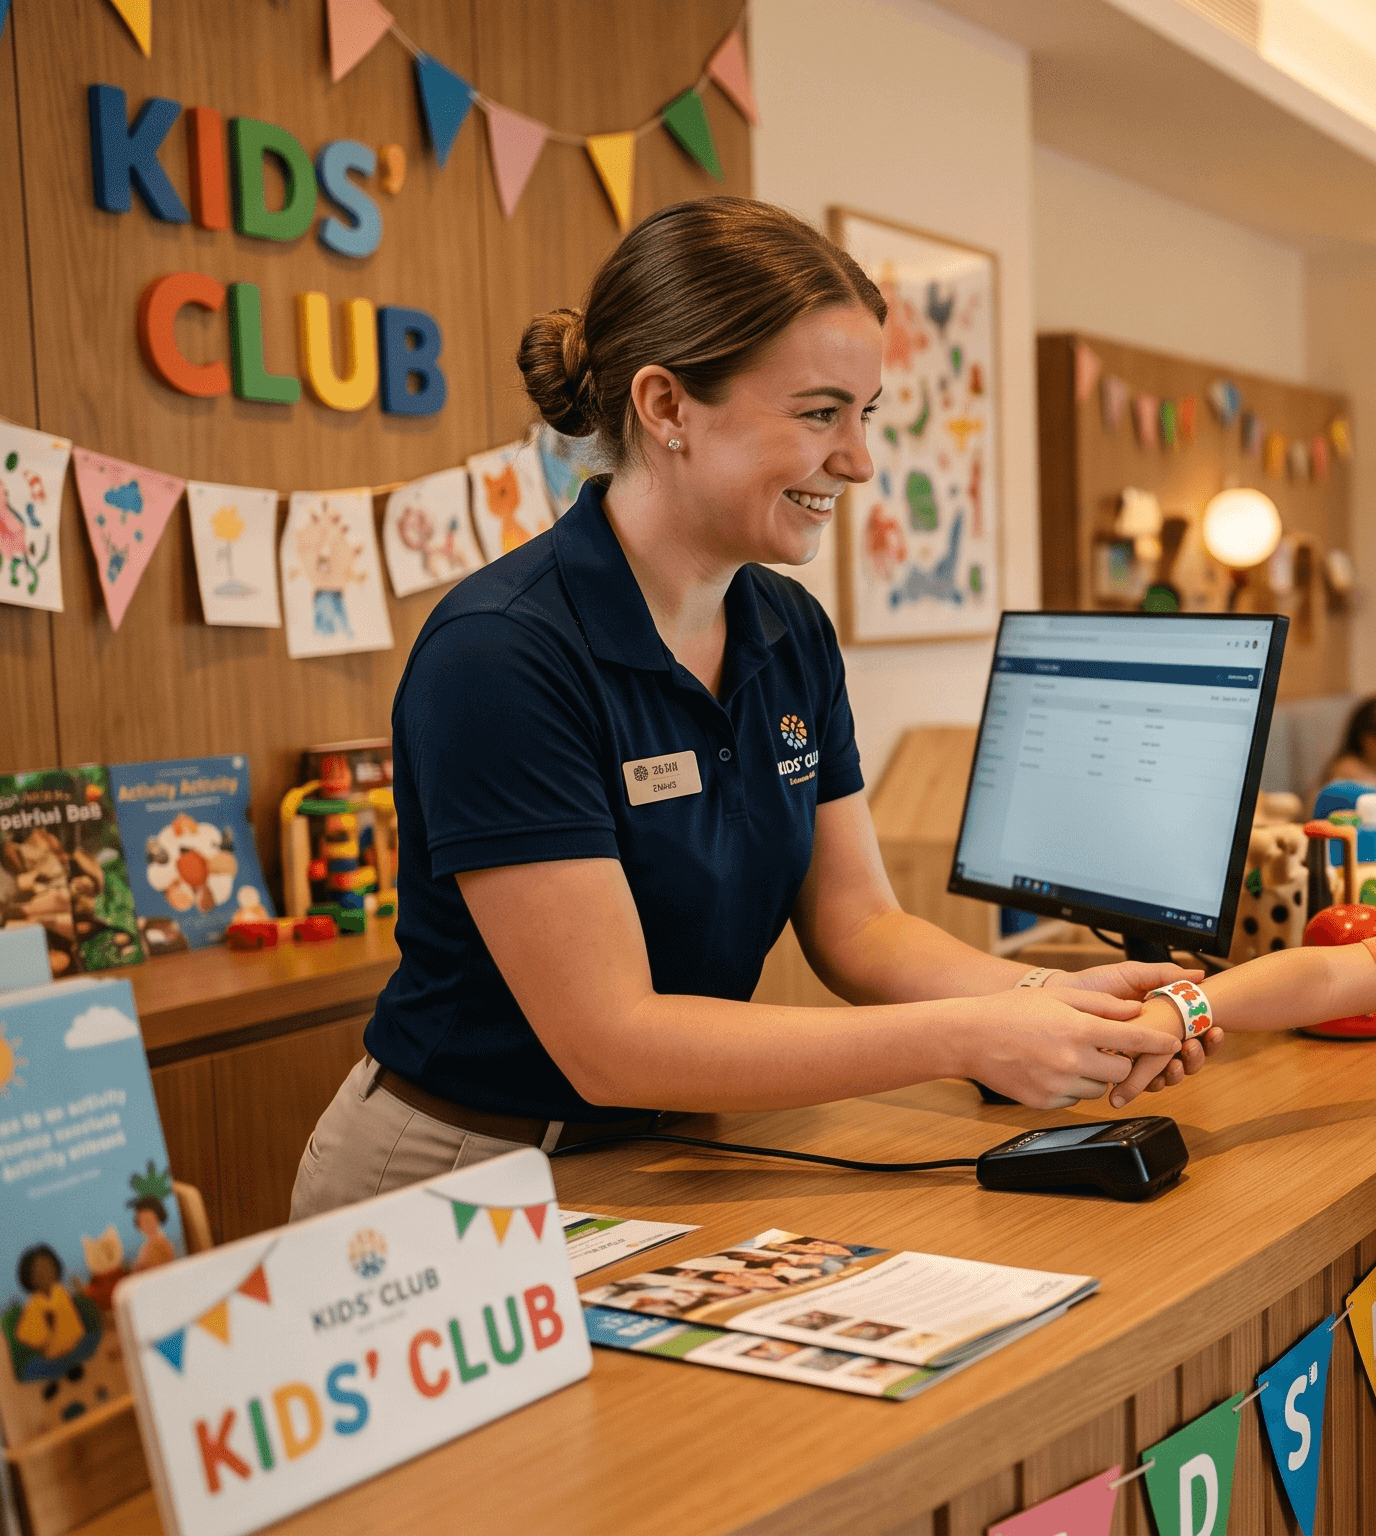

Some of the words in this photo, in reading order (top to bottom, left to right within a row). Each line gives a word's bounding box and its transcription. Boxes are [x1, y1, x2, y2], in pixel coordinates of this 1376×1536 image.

[88, 83, 406, 259] KIDS'
[137, 271, 449, 417] CLUB
[379, 1266, 440, 1307] CLUB
[193, 1348, 380, 1497] KIDS'
[406, 1282, 565, 1399] CLUB
